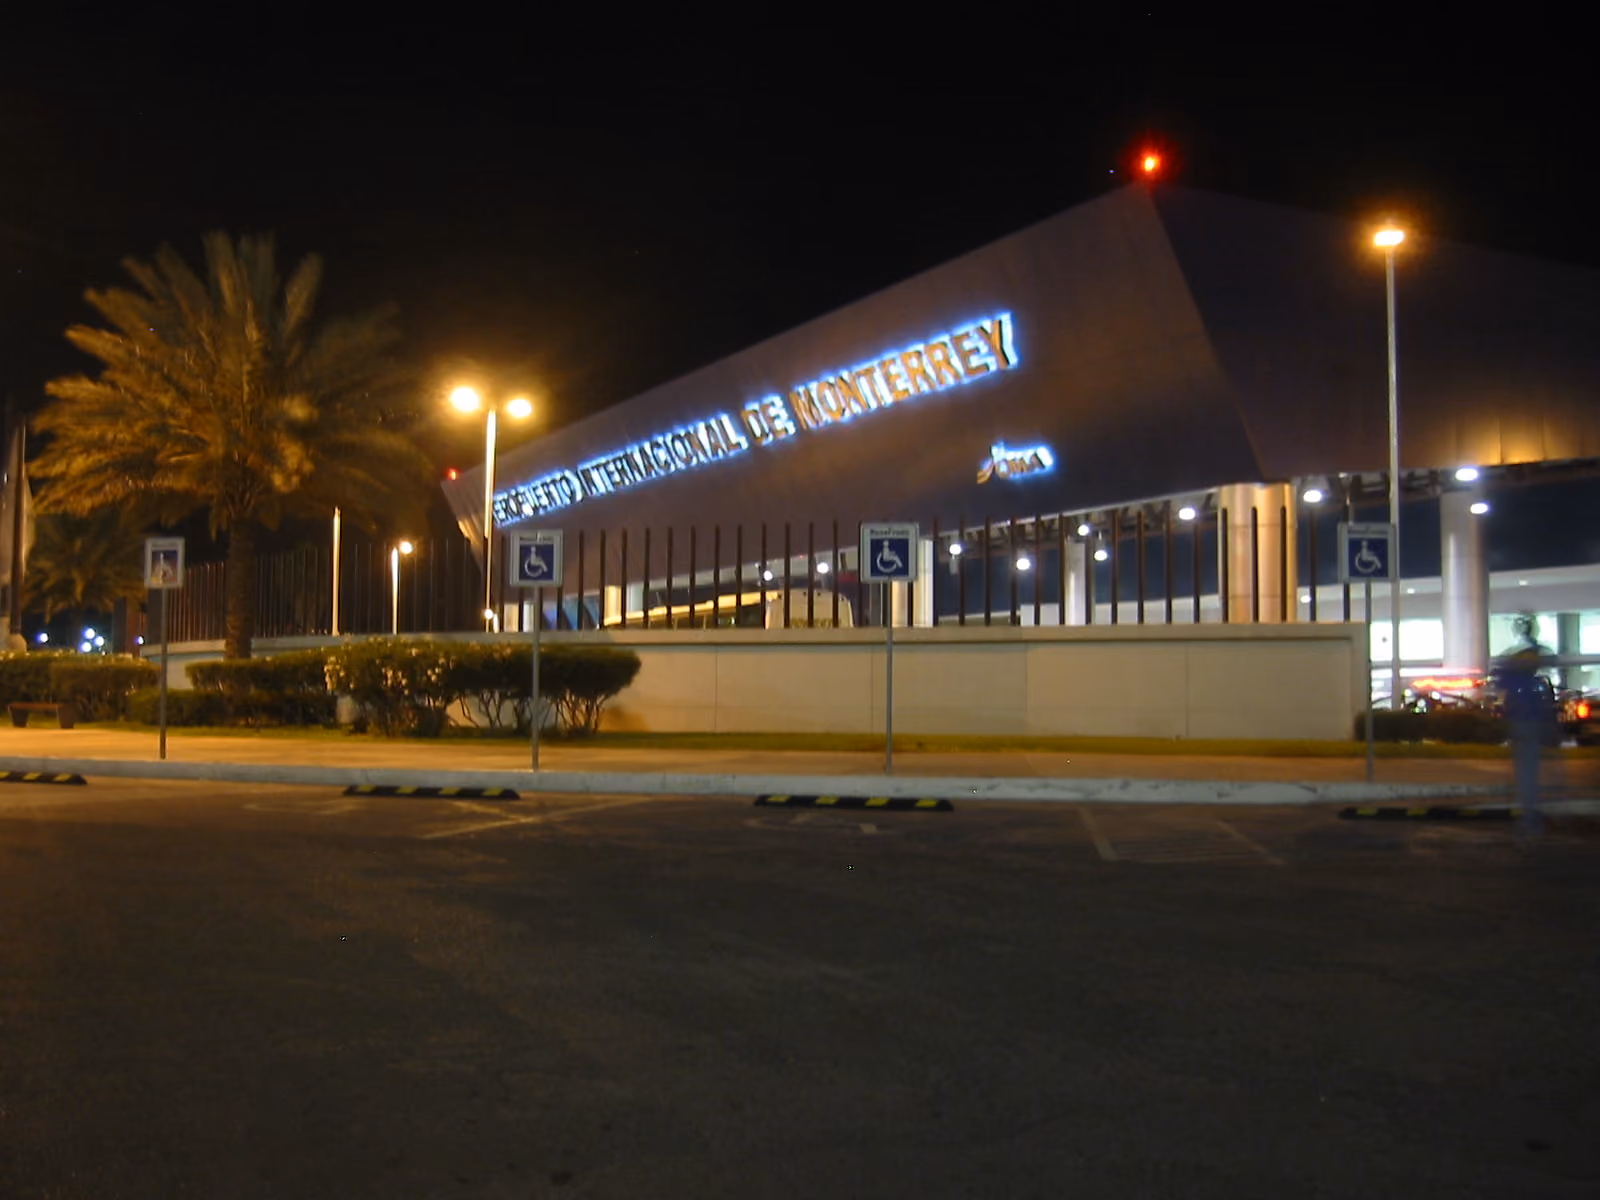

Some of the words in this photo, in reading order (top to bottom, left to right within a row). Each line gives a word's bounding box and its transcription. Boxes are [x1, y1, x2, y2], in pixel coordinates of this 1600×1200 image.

[493, 471, 582, 524] EROPUERTO
[577, 414, 748, 497] INTERNACIONAL
[740, 394, 796, 446] DE
[789, 314, 1016, 430] MONTERREY
